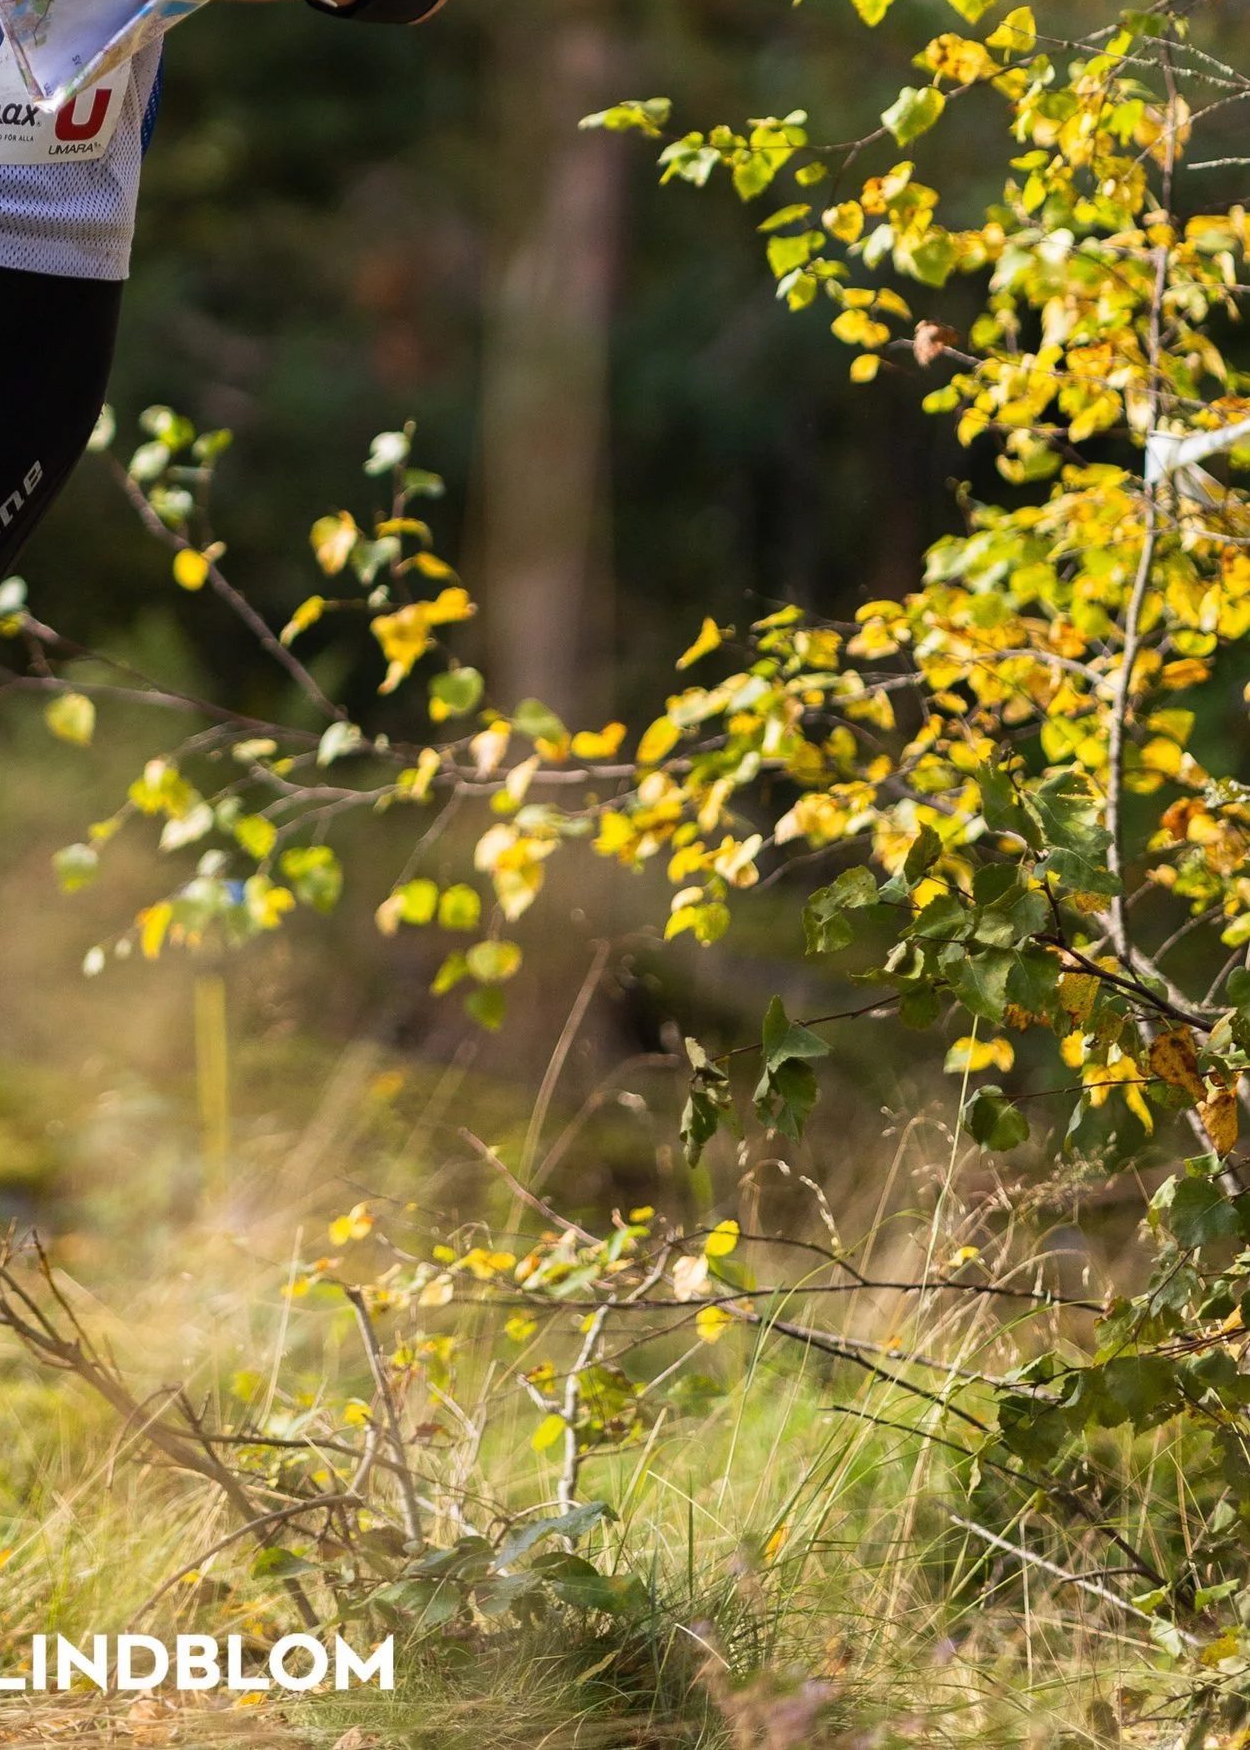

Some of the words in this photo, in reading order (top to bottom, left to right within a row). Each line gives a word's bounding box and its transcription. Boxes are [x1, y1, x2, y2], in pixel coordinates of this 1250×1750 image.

[4, 133, 17, 142] FÖR
[18, 134, 34, 142] ALLA
[48, 142, 94, 155] UMARA
